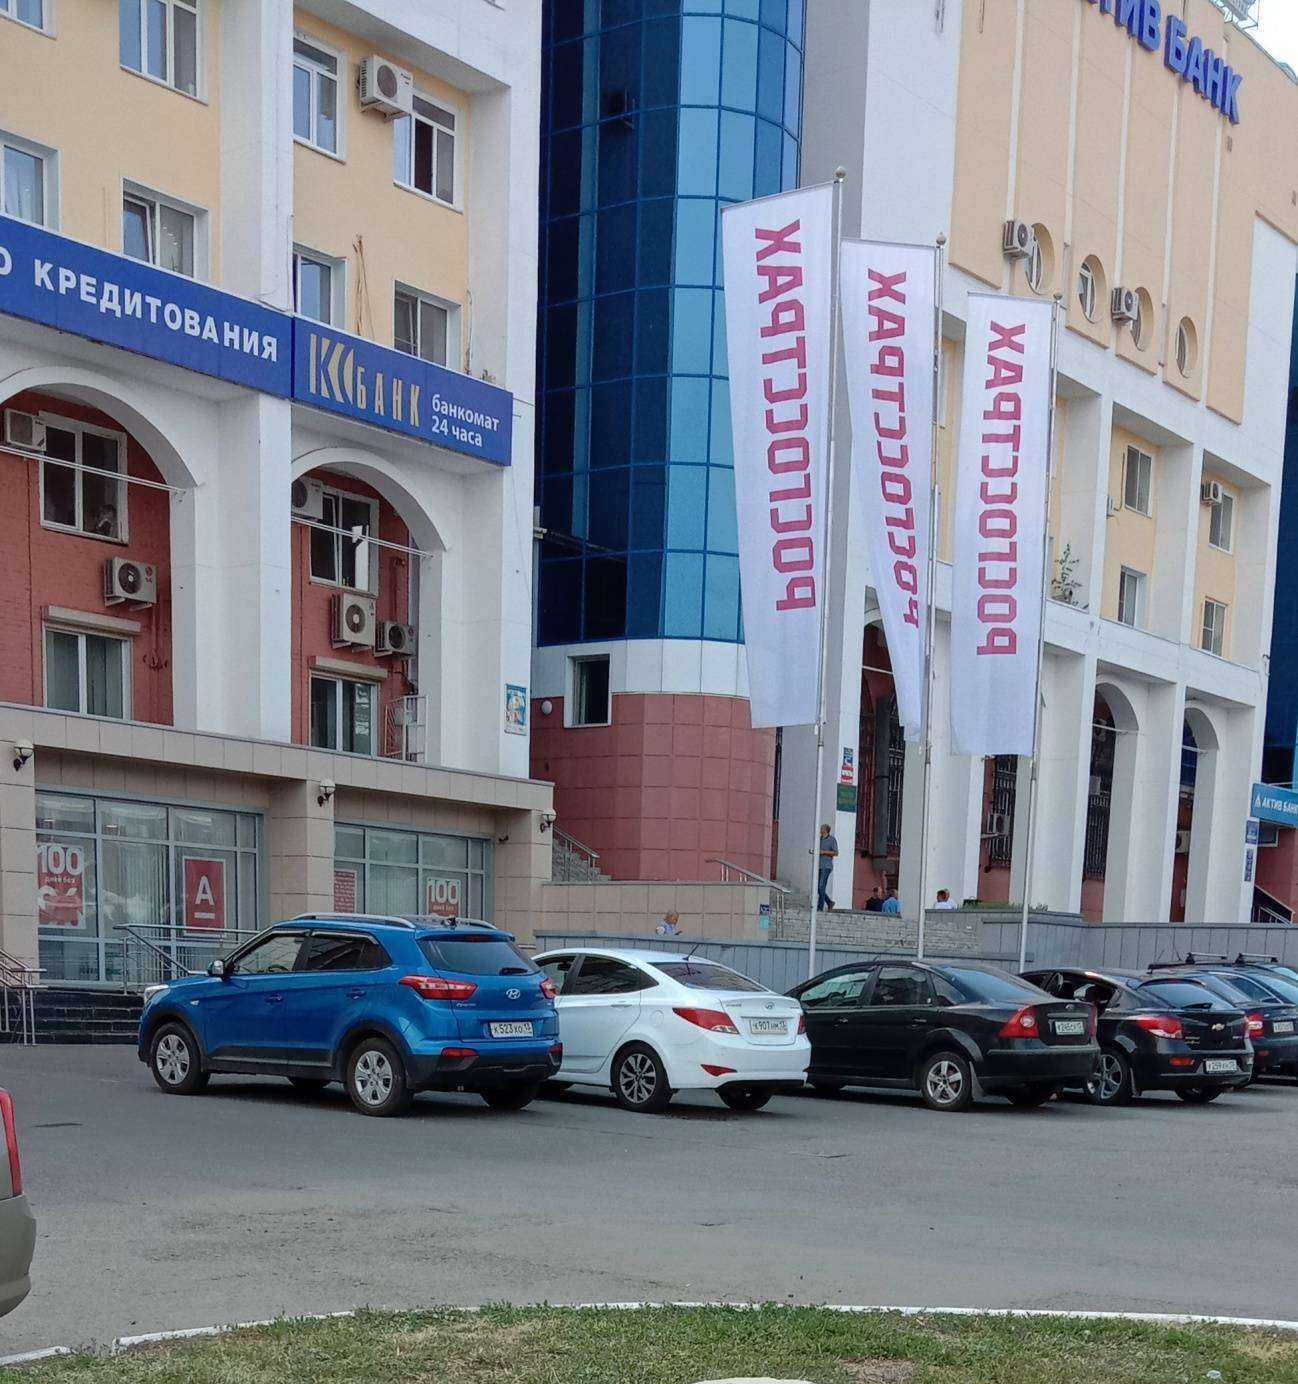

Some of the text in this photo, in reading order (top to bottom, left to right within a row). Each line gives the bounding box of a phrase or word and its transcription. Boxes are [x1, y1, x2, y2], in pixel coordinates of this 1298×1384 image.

[1164, 14, 1243, 125] БАНК
[34, 258, 278, 362] КРЕДИТОВАНИЯ
[357, 365, 420, 428] БАНК
[432, 393, 500, 432] банкомат
[431, 415, 483, 447] 24 часа
[35, 843, 84, 876] 100
[427, 879, 459, 904] 100
